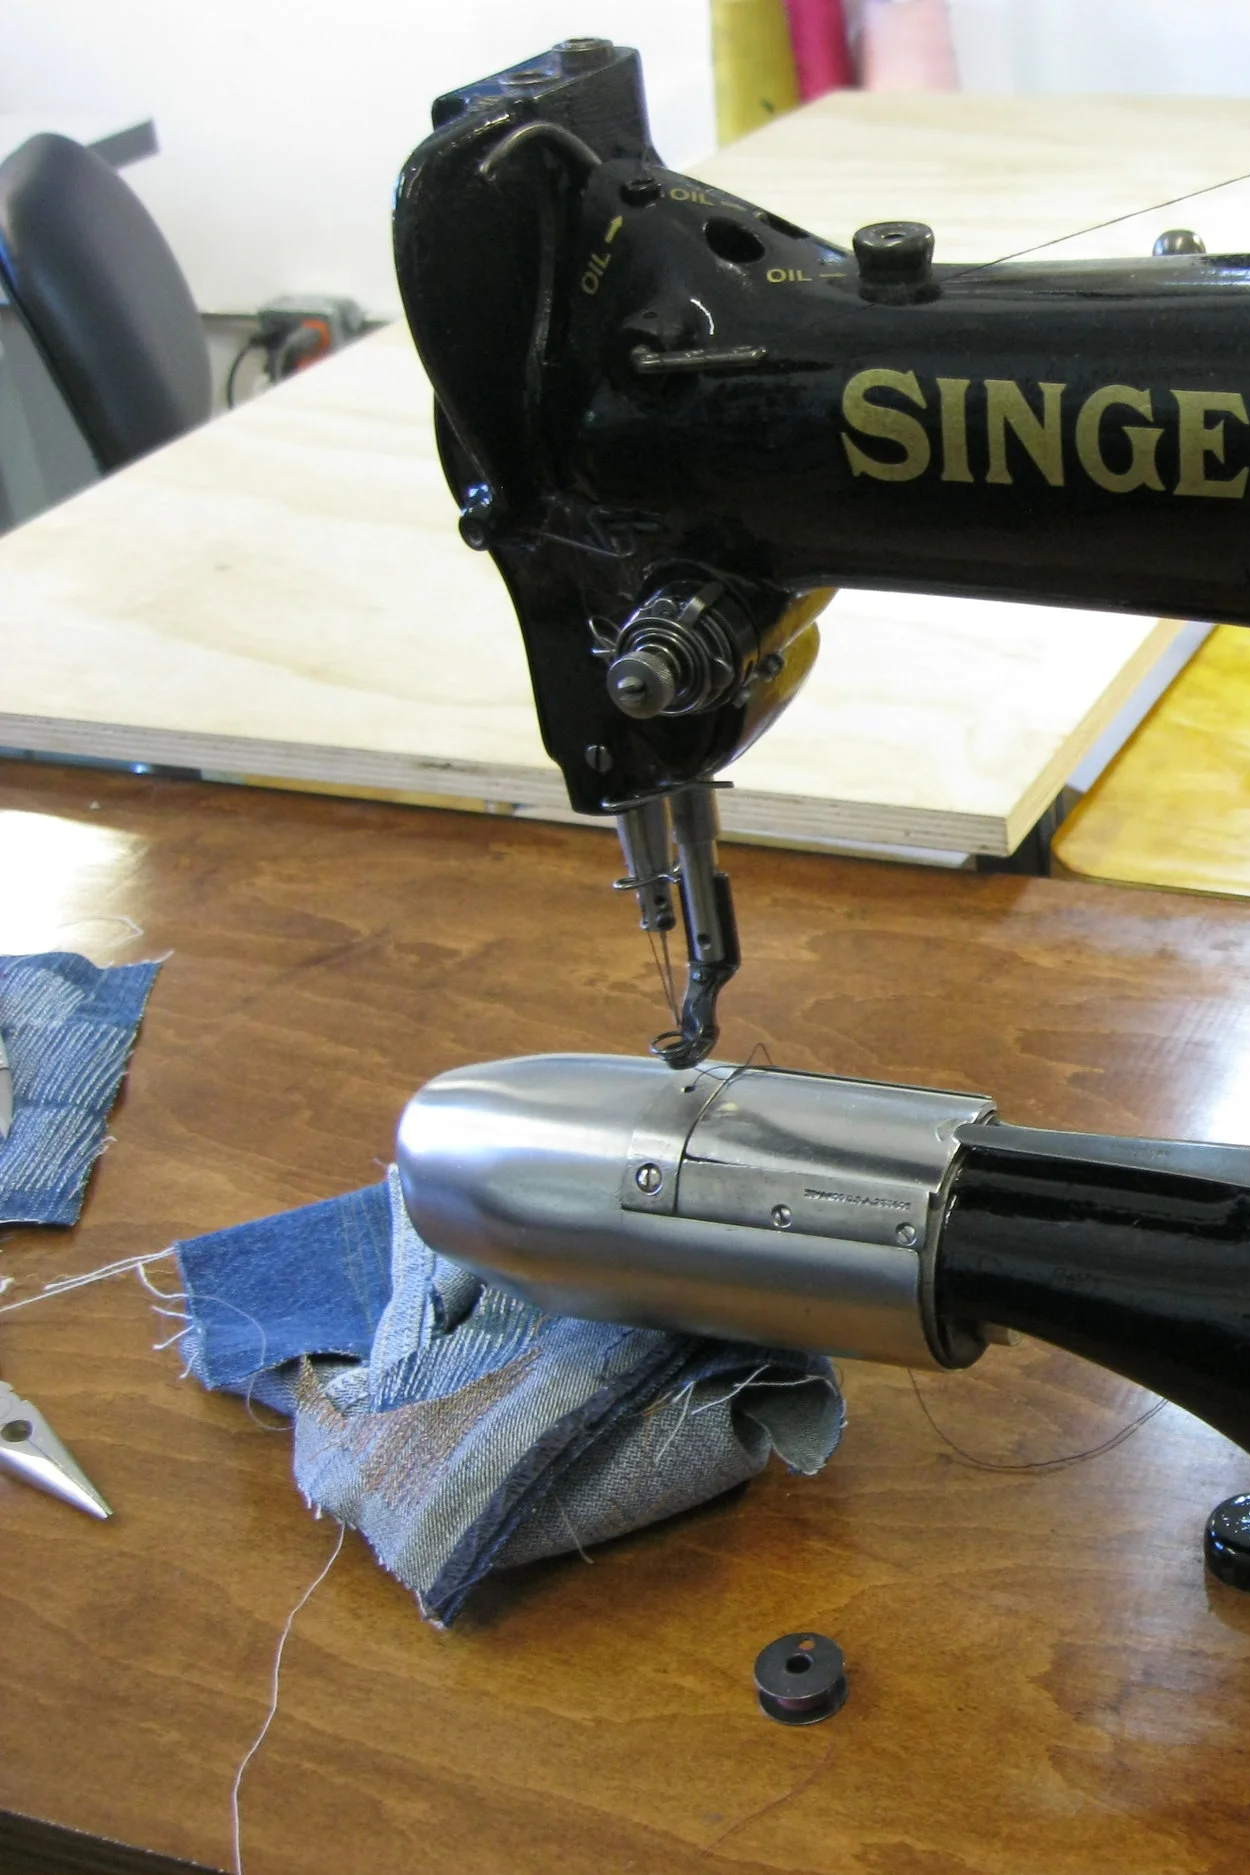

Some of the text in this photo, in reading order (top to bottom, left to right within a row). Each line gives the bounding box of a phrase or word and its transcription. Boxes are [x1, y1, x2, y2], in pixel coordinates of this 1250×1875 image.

[669, 188, 714, 206] OIL
[581, 253, 611, 295] OIL
[766, 268, 813, 283] OIL
